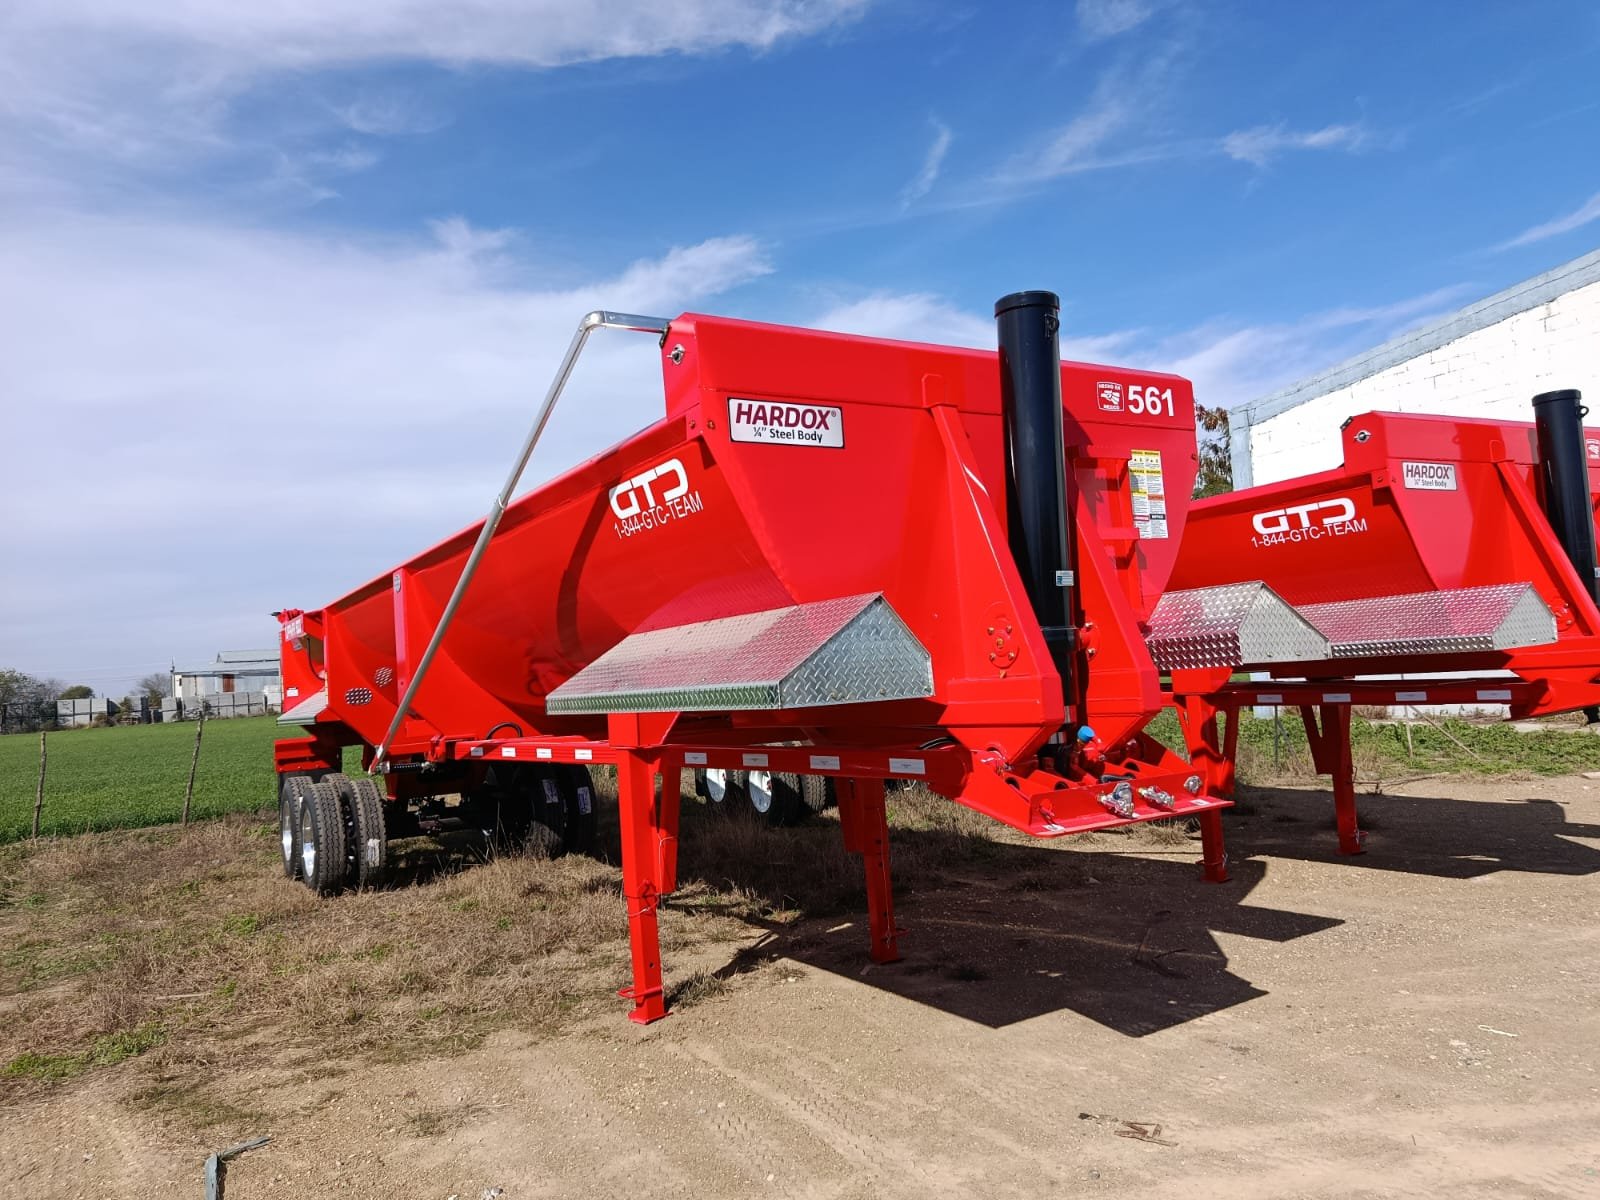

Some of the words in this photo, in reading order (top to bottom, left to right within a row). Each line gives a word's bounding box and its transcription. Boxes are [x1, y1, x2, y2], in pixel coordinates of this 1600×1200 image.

[1128, 385, 1174, 416] 561
[769, 428, 795, 440] Steel
[797, 431, 823, 443] Body
[614, 490, 704, 539] 1-844-GTC-TEAM
[1251, 518, 1368, 548] 1-844-GTC-TEAM
